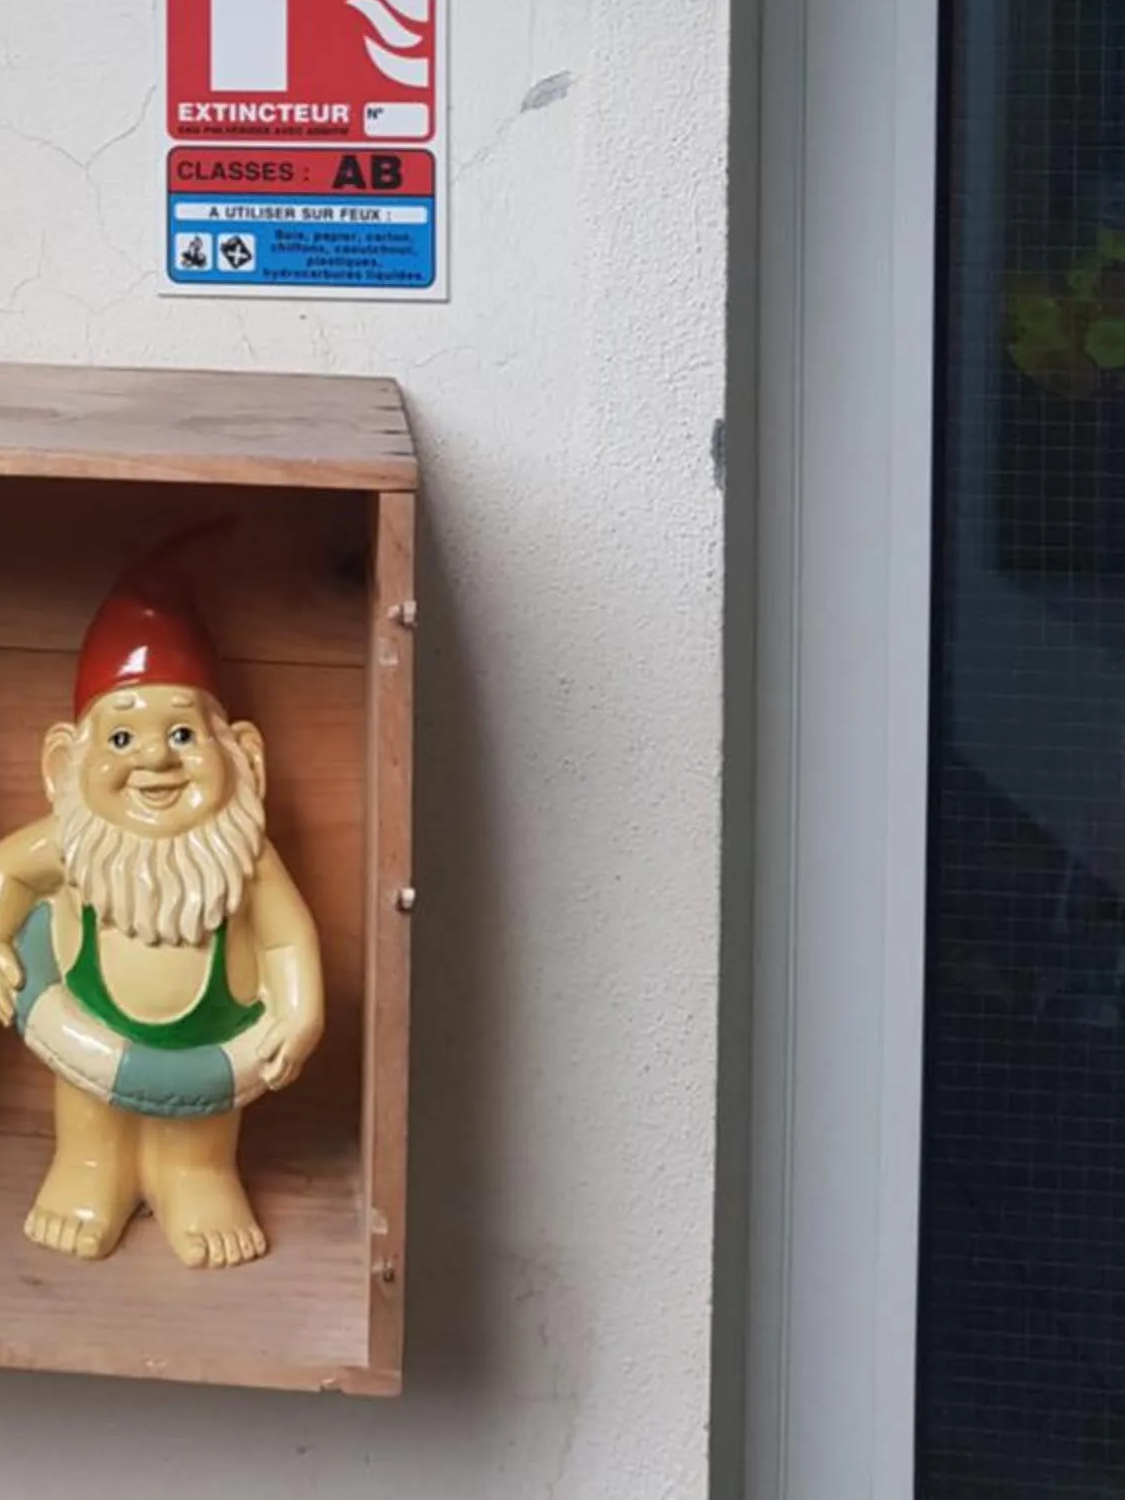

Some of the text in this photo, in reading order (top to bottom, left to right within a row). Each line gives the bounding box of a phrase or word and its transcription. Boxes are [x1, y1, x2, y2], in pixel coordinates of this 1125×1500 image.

[177, 102, 350, 123] EXTINCTEUR
[177, 160, 295, 181] CLASSES
[331, 155, 403, 189] AB
[208, 206, 220, 218] A
[225, 206, 295, 219] UTILISER
[301, 207, 335, 220] SUR
[340, 208, 381, 221] FEUX
